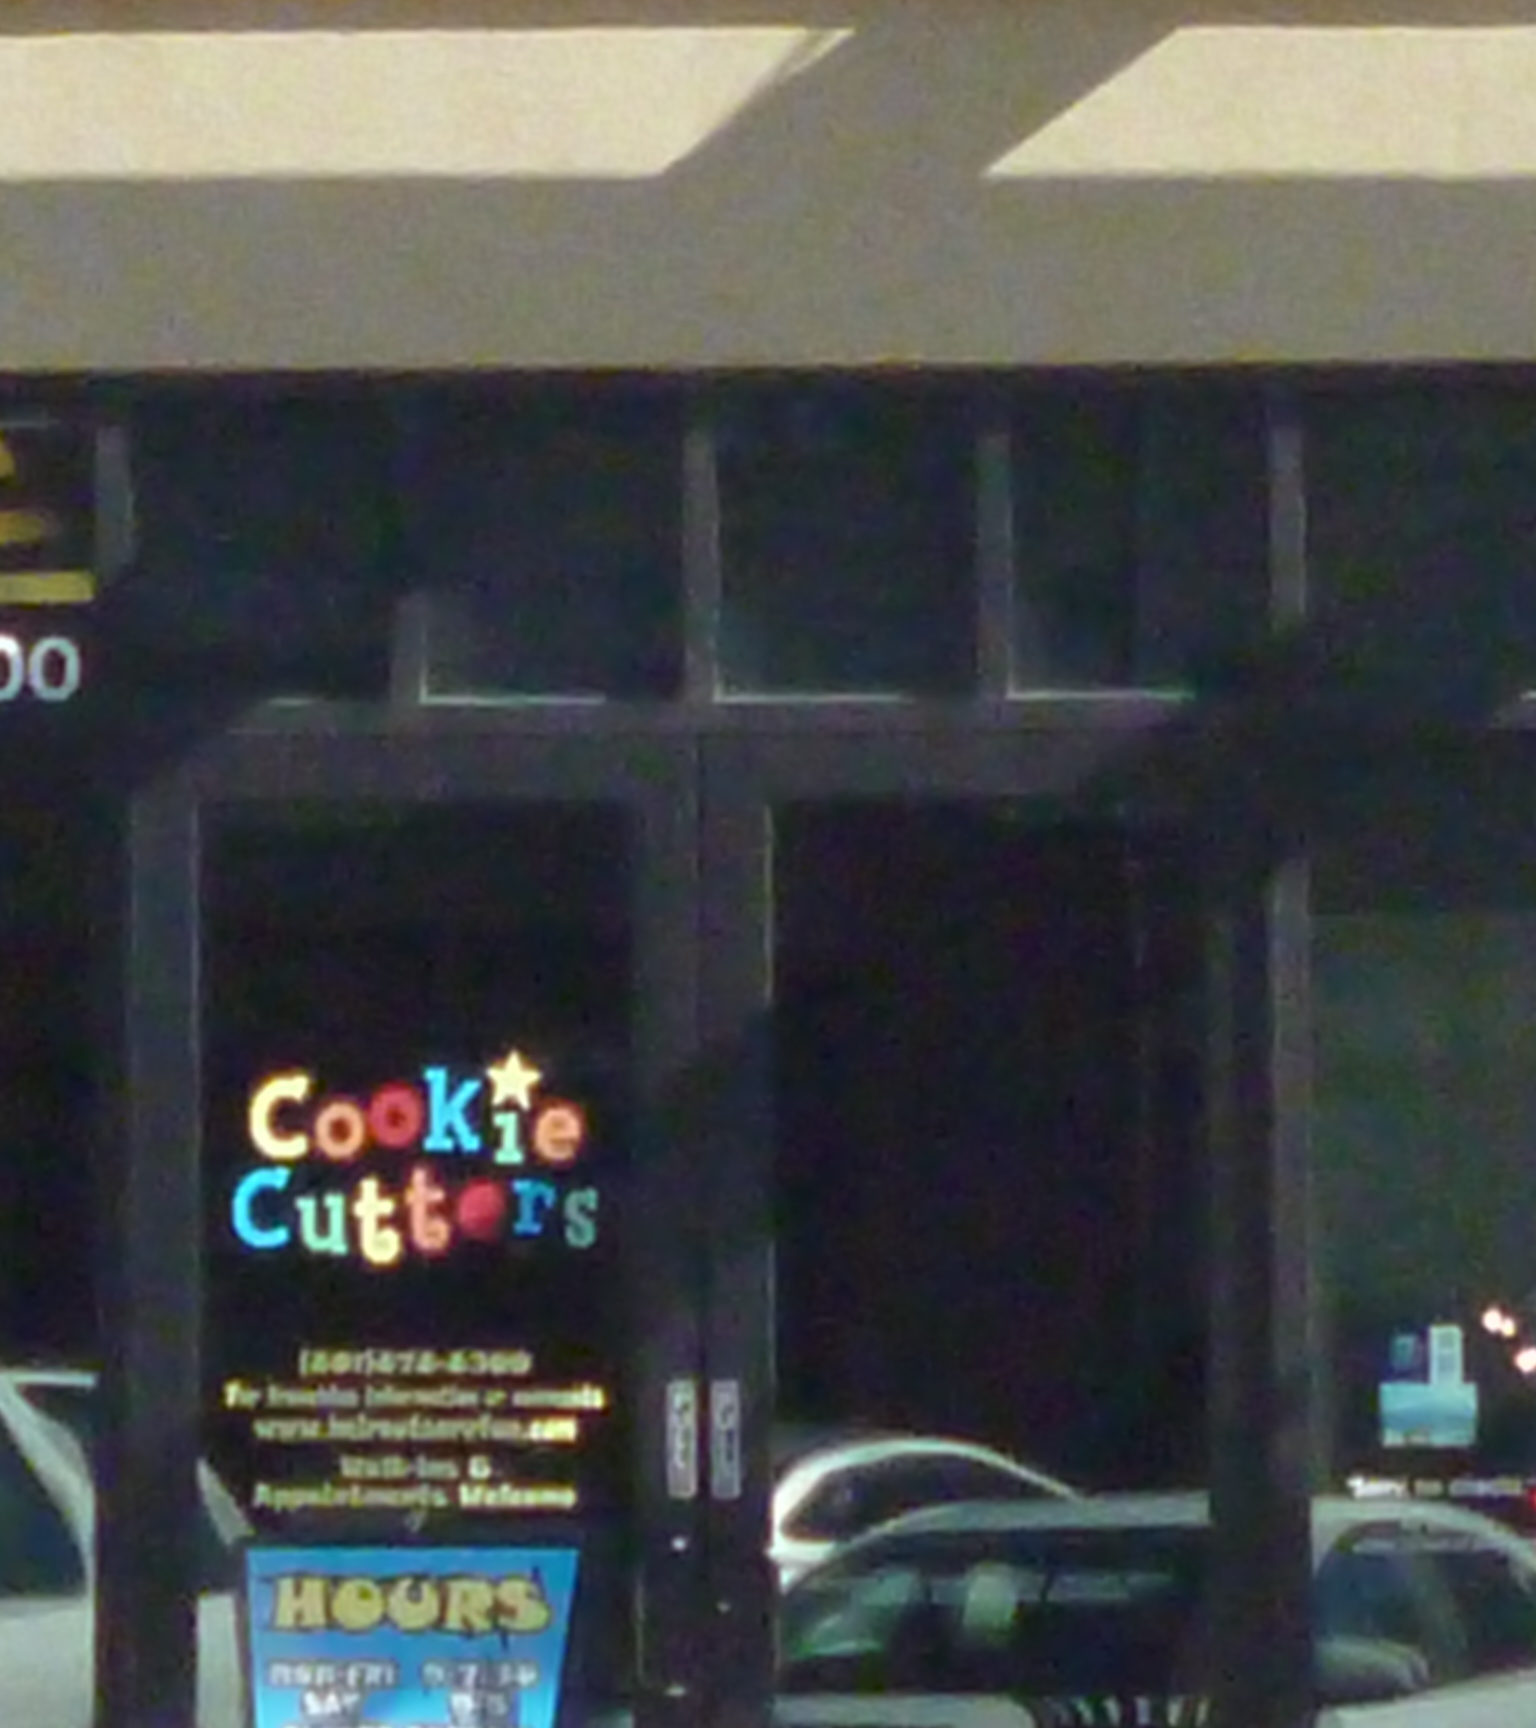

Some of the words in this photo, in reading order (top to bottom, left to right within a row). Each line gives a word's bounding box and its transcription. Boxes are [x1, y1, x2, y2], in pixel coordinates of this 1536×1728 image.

[248, 1049, 585, 1165] Cookie
[231, 1165, 599, 1266] Cutters
[273, 1574, 553, 1634] HOURS
